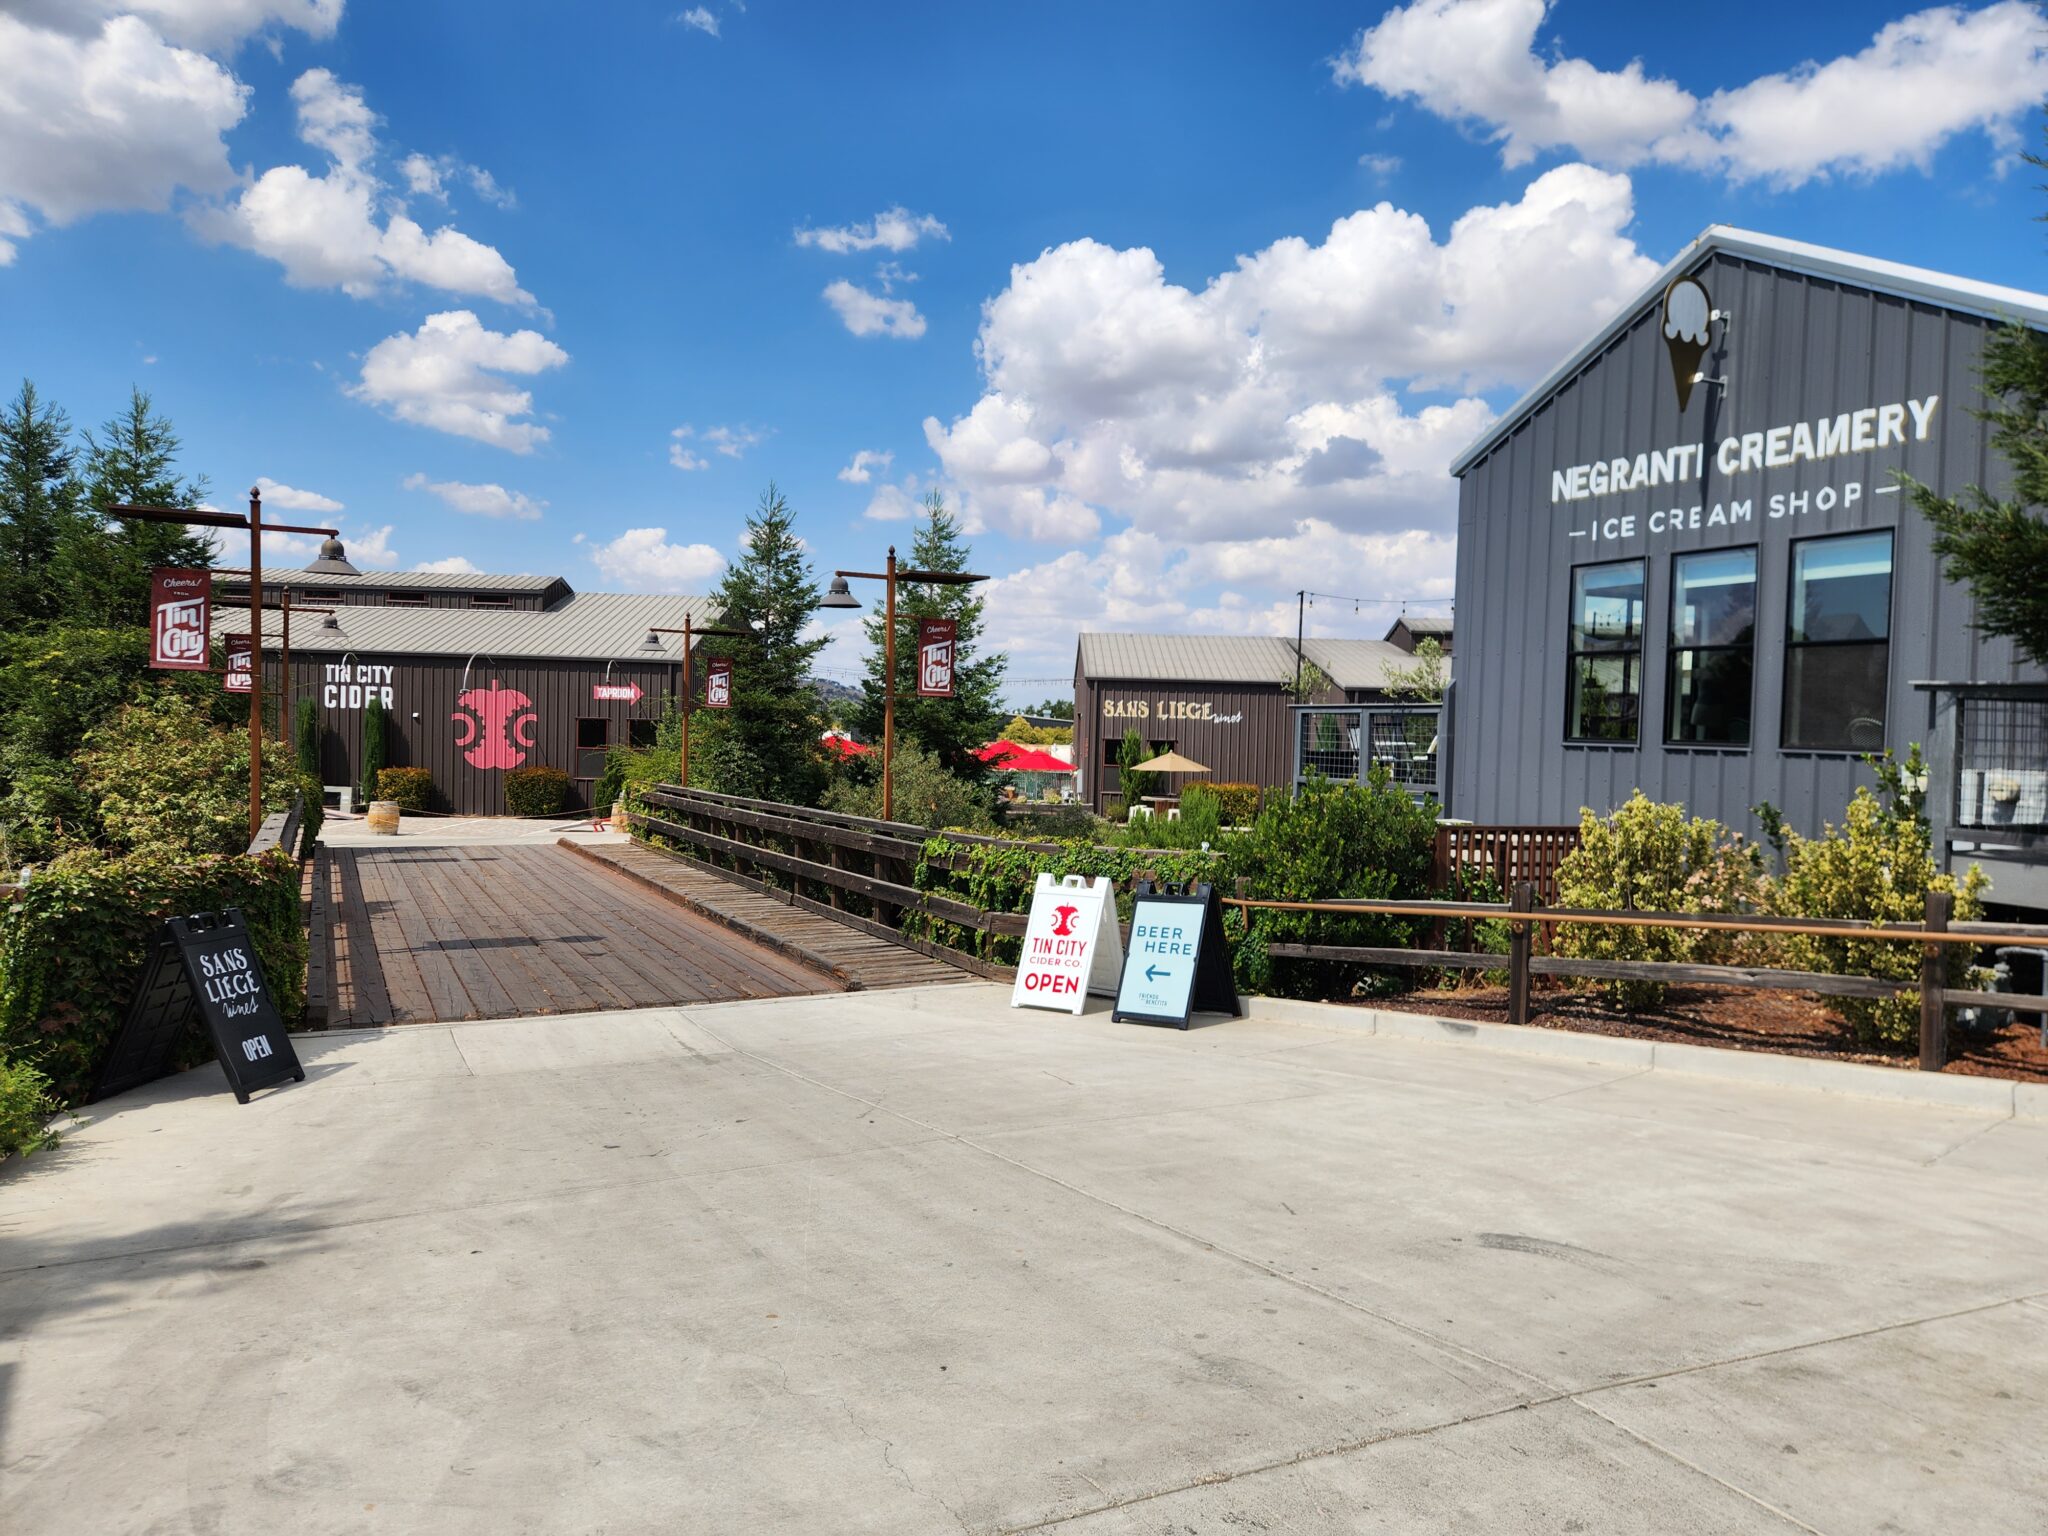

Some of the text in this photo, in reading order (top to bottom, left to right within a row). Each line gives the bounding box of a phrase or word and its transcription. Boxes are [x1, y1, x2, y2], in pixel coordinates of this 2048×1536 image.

[1552, 395, 1939, 503] NEGRANTI CREAMERY
[1591, 481, 1862, 541] ICE CREAM SHOP
[163, 578, 202, 588] Cheers!
[157, 597, 205, 630] Tin
[162, 628, 204, 658] City
[923, 640, 952, 666] Tin
[325, 664, 394, 684] TIN CITY
[925, 664, 951, 687] City
[324, 685, 394, 710] CIDER
[597, 687, 636, 699] TAPROOM
[1103, 699, 1150, 718] SANS
[1157, 700, 1214, 720] LIEGE
[1137, 925, 1183, 939] BEER
[1032, 937, 1088, 957] TIN CITY
[1145, 941, 1192, 955] HERE
[200, 947, 248, 977] SANS
[1029, 956, 1062, 966] CIDER
[204, 970, 260, 1004] LIEGE
[1024, 972, 1080, 994] OPEN
[241, 1034, 273, 1062] OPEN
